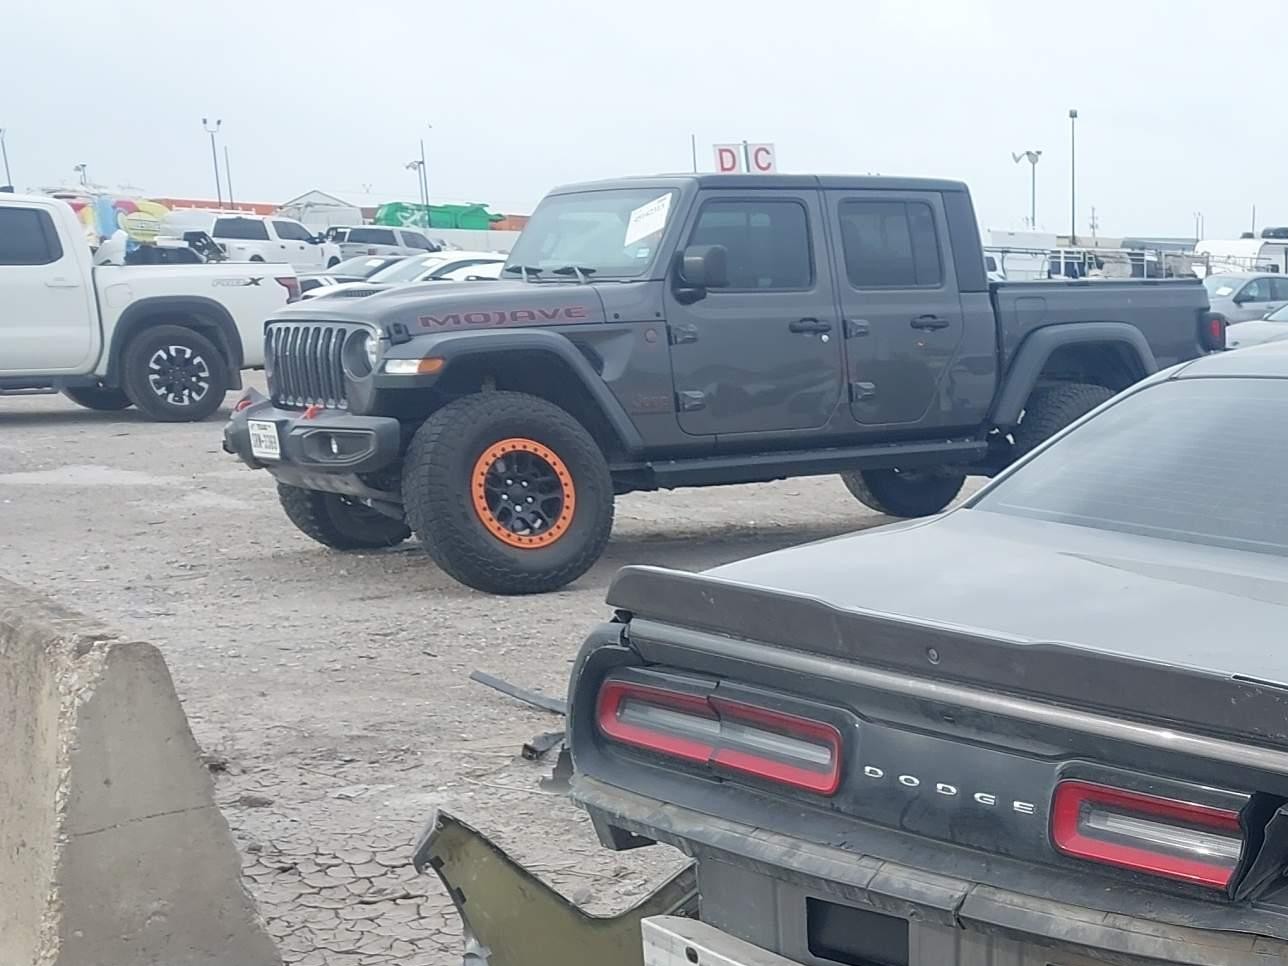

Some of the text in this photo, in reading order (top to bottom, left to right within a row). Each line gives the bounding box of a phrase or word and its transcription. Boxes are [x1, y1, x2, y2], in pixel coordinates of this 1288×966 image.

[718, 148, 736, 171] D
[754, 146, 772, 171] C
[418, 305, 589, 328] MOJAVE
[863, 765, 1035, 815] DODGE
